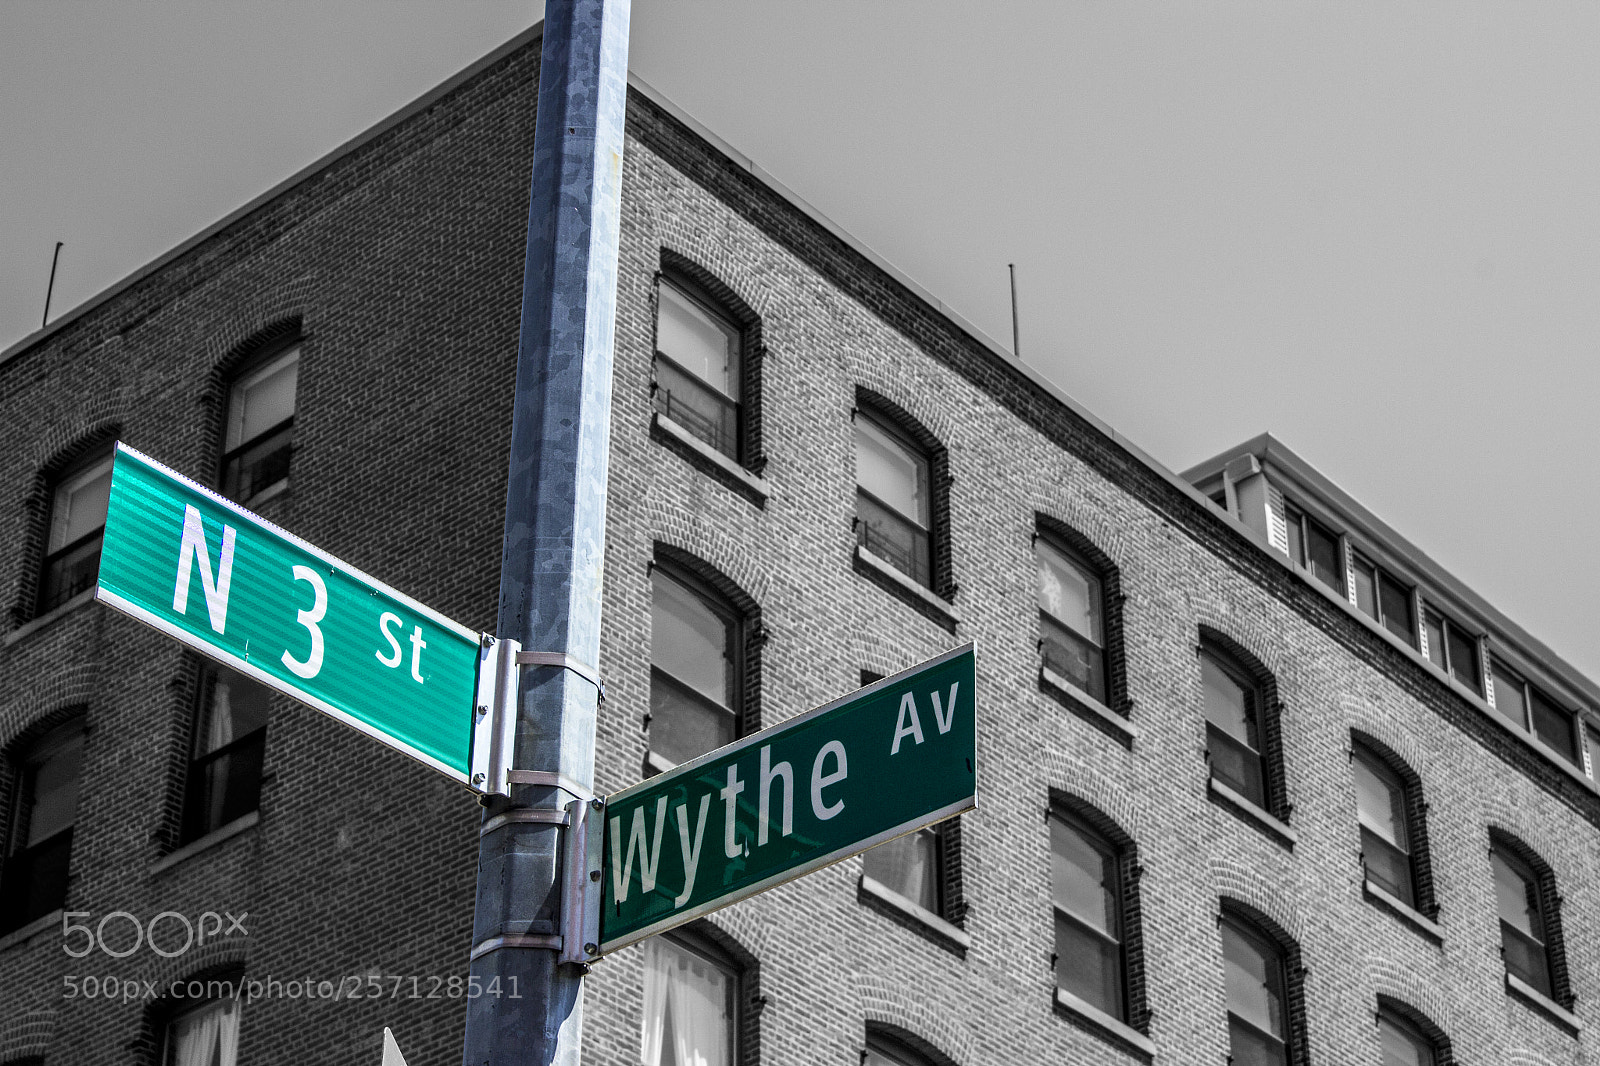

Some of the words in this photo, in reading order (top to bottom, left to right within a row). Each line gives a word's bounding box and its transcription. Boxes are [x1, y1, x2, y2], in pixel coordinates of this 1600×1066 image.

[173, 503, 236, 634] N
[281, 565, 328, 679] 3
[375, 612, 426, 684] St
[609, 740, 848, 908] Wythe
[890, 681, 960, 755] Av
